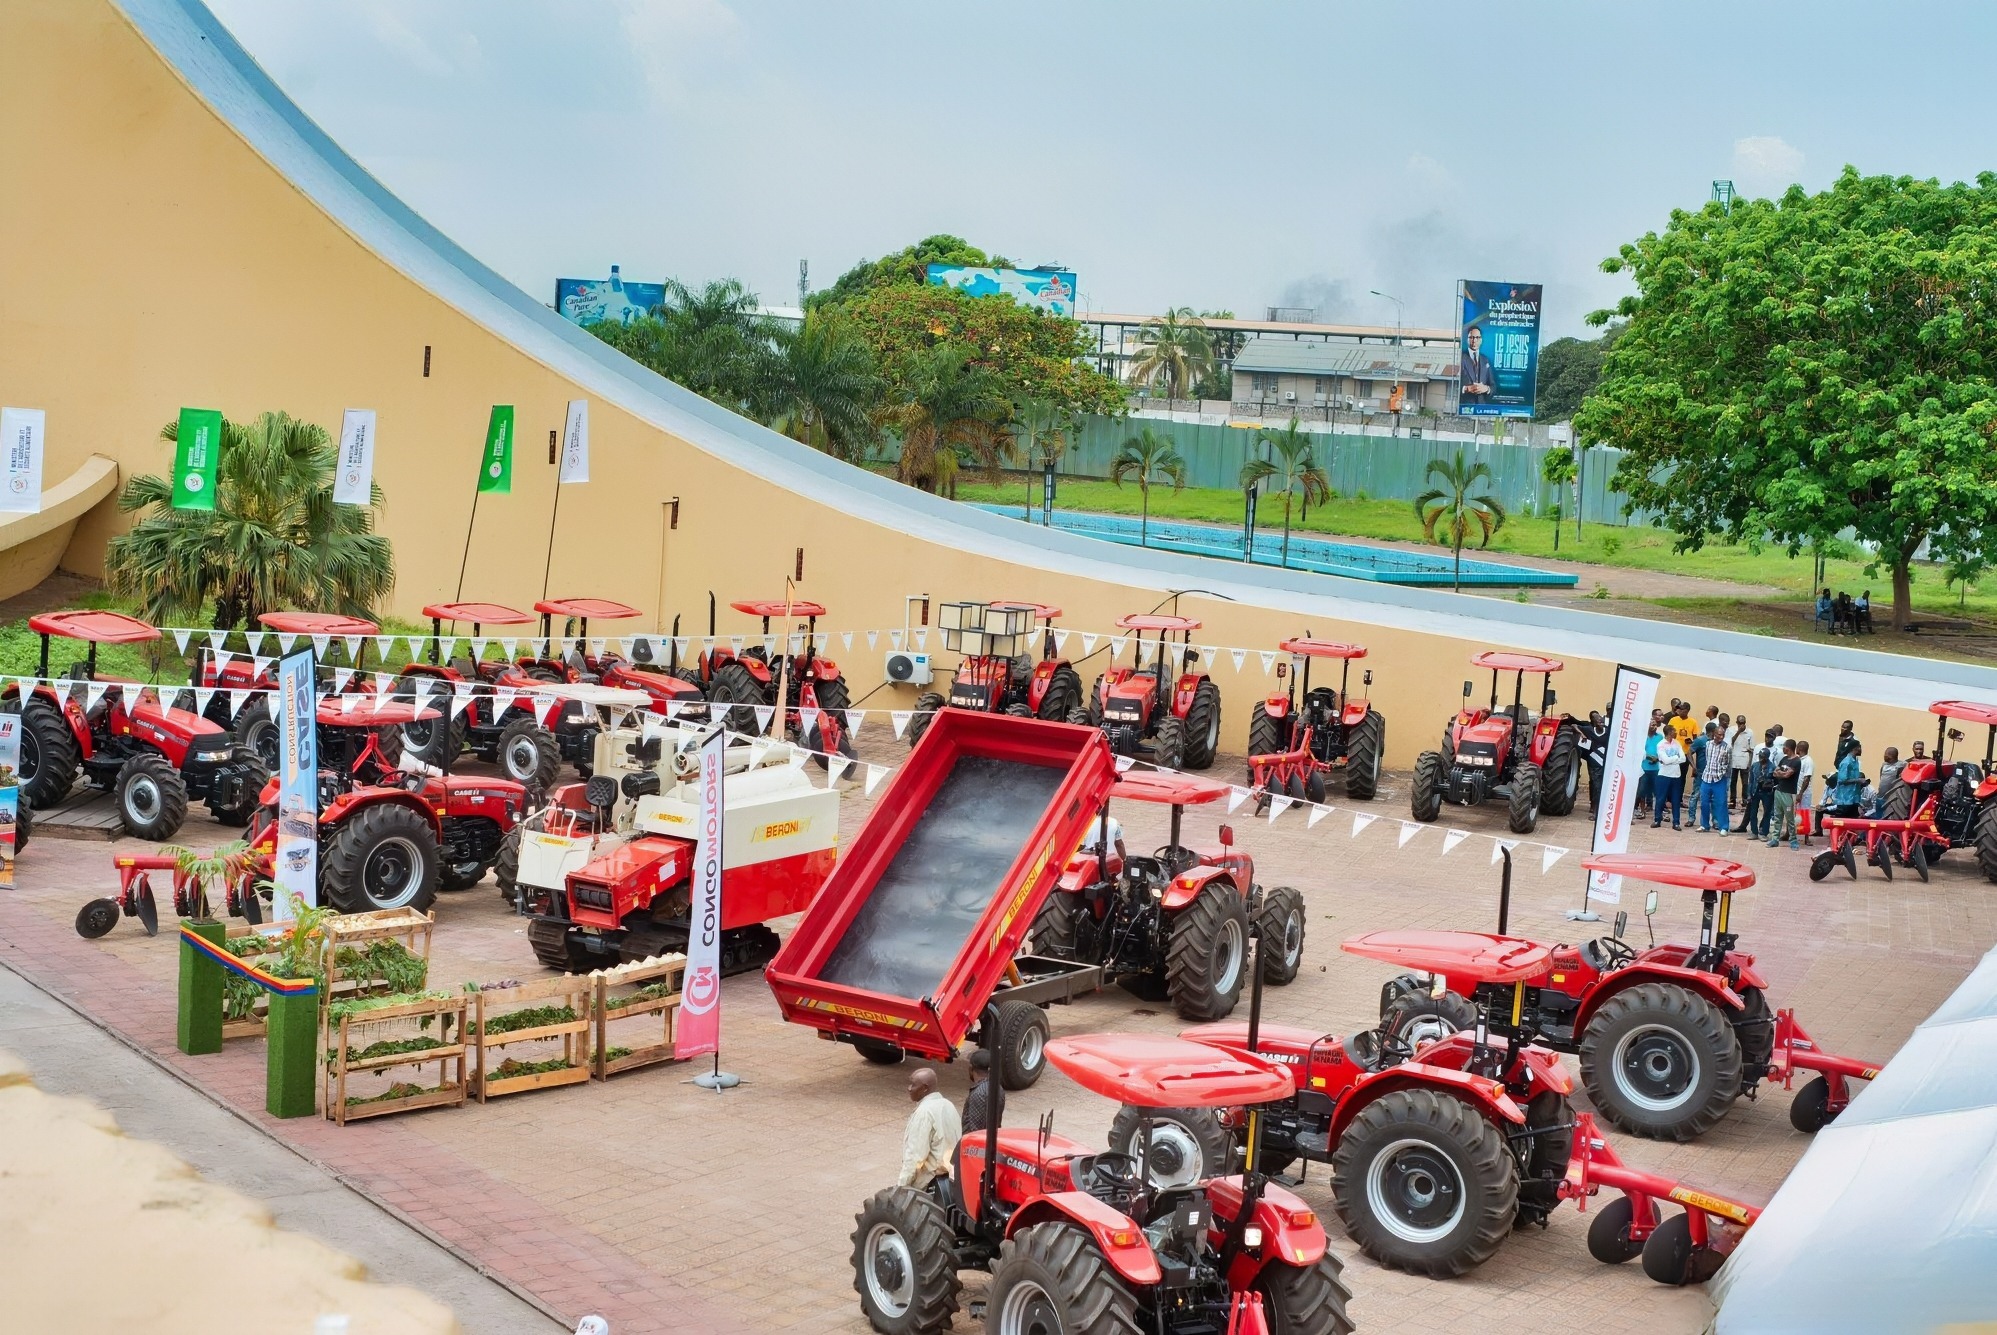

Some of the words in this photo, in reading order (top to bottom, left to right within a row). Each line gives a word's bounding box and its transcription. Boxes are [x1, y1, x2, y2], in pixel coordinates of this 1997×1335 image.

[1040, 286, 1071, 298] Canadian
[565, 295, 598, 305] Canadian
[573, 303, 590, 312] Pure
[226, 674, 240, 682] CASE
[136, 719, 150, 729] CASE
[1617, 681, 1639, 760] GASPARDO
[454, 789, 472, 797] CASE
[1604, 769, 1619, 831] MASCHIO
[659, 813, 683, 823] BERONI
[765, 820, 799, 838] BERONI
[1008, 868, 1038, 919] BERONI
[833, 1004, 889, 1024] BERONI
[1260, 1052, 1288, 1063] CASE
[1006, 1157, 1028, 1173] CASE
